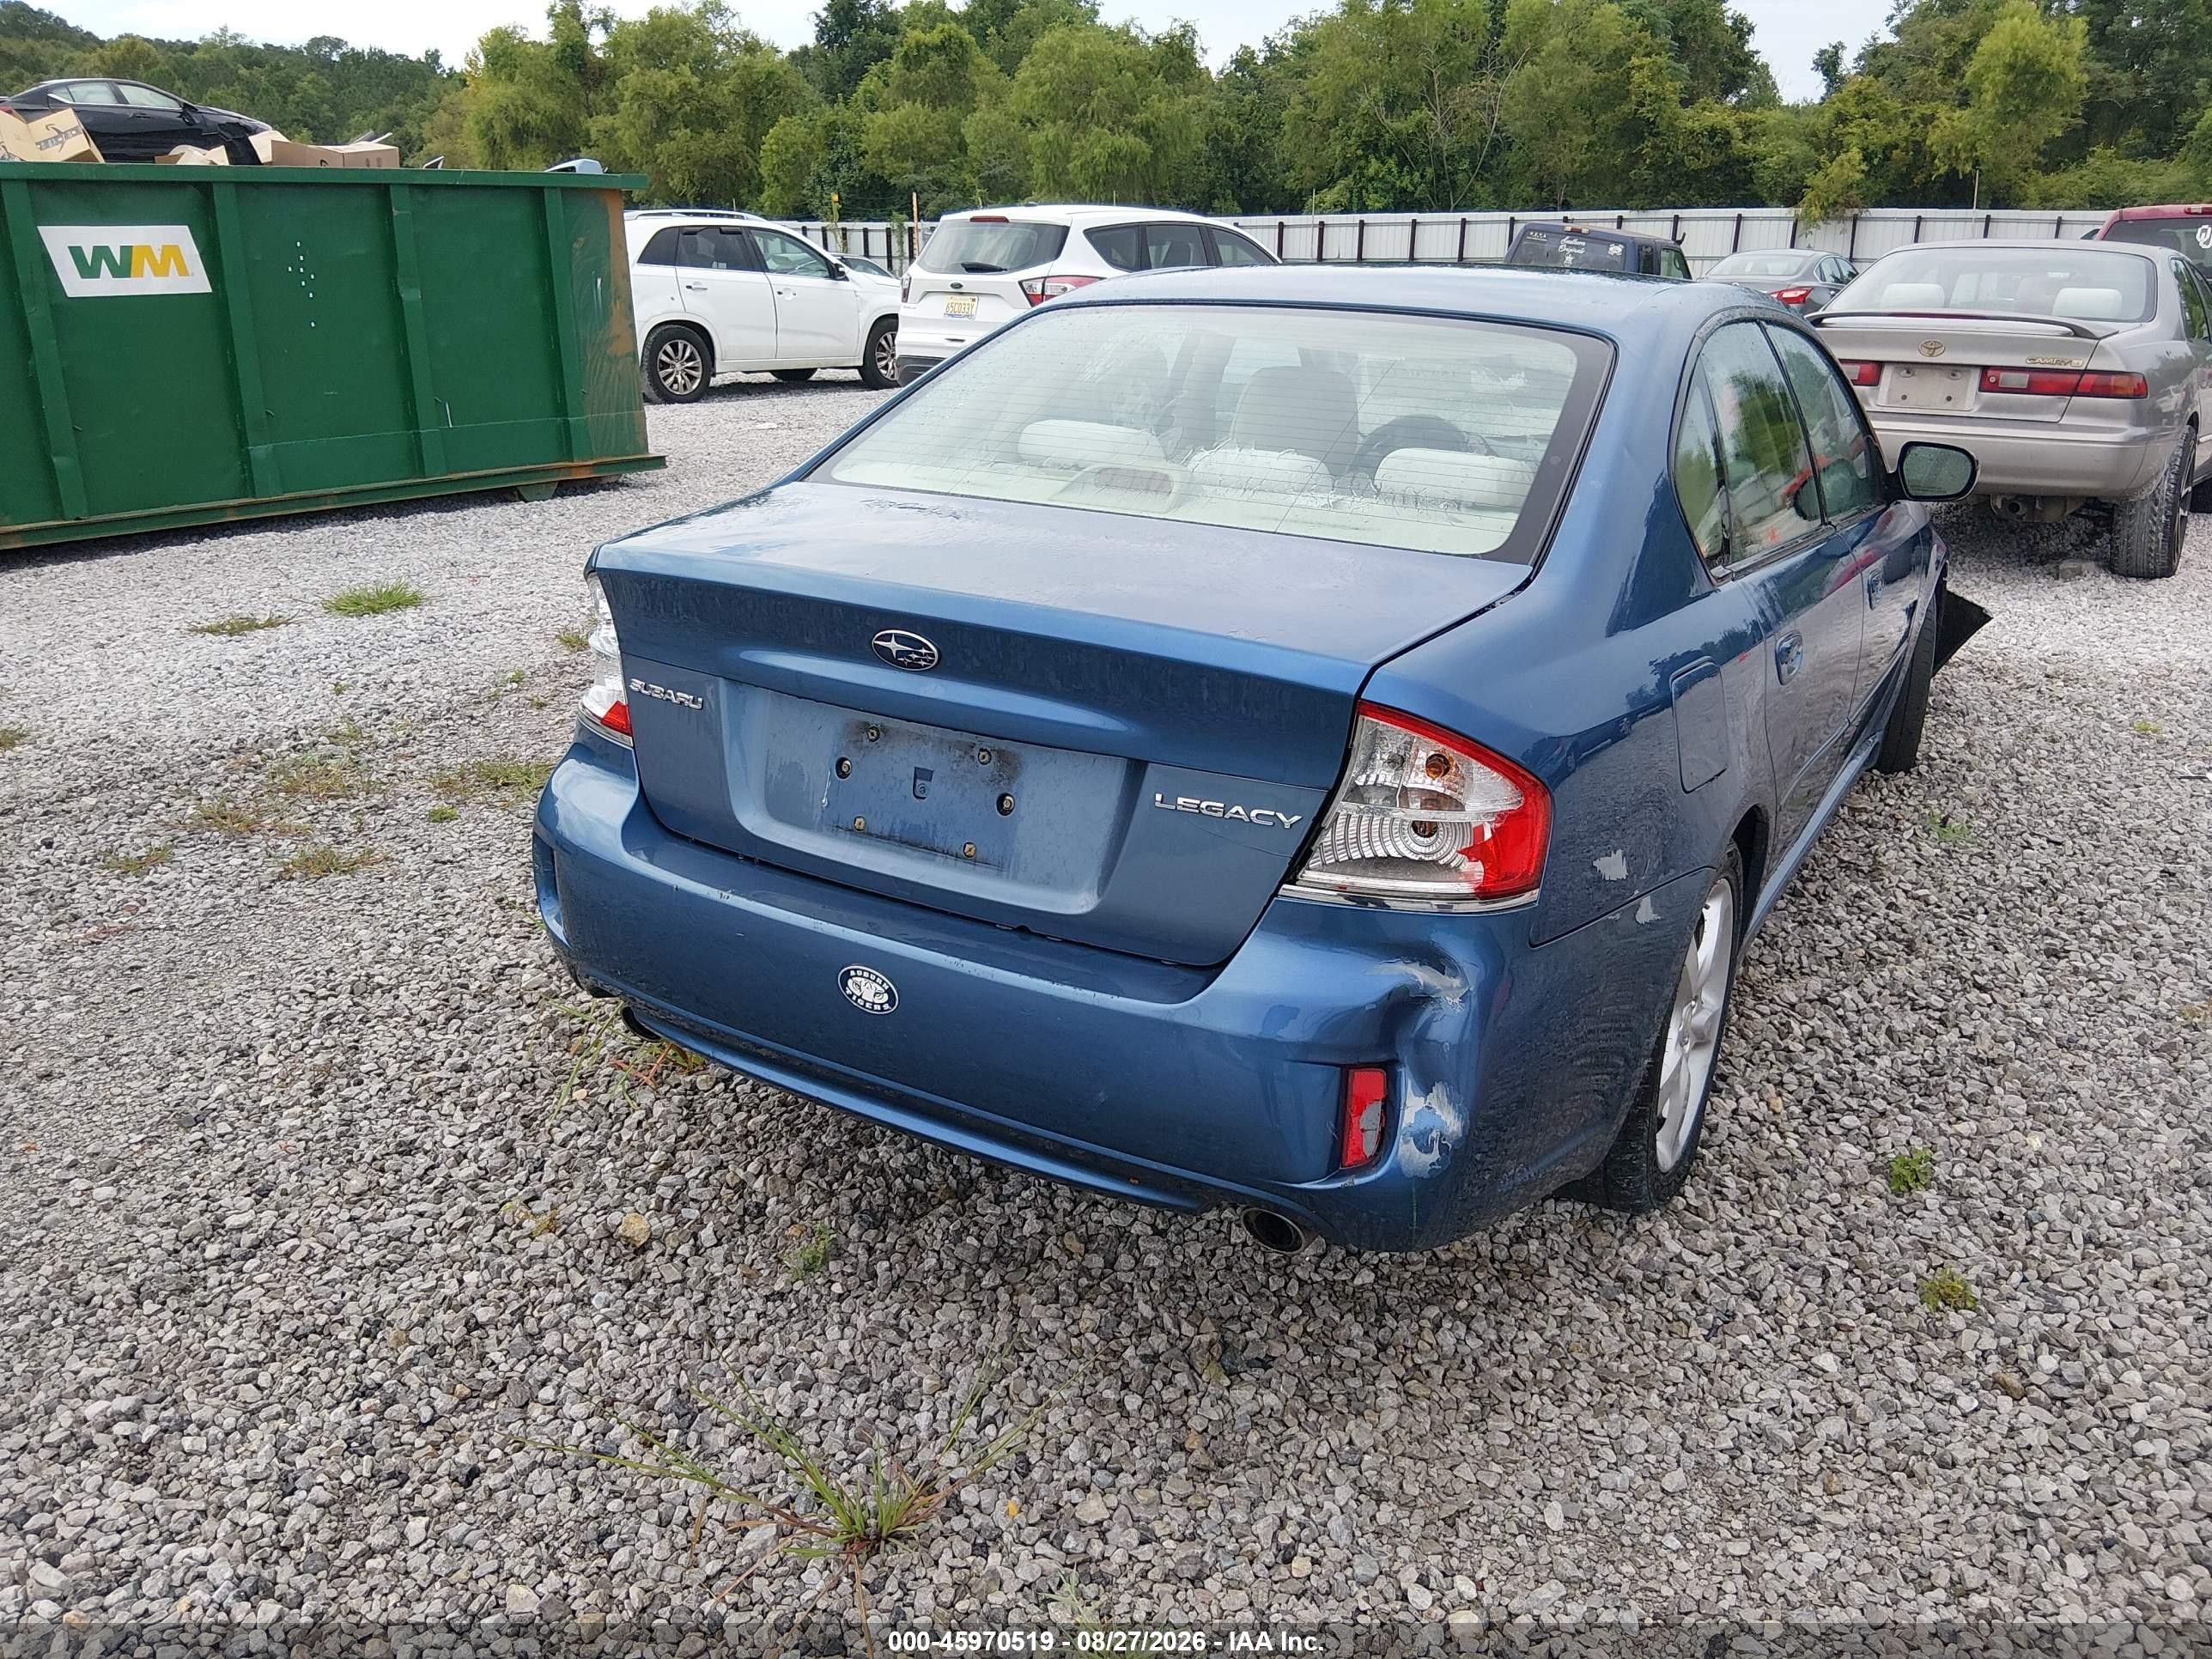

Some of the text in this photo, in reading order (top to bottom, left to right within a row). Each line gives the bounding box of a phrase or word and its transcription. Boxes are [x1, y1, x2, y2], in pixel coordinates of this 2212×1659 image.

[68, 245, 191, 279] WM
[2027, 357, 2071, 366] CAMRY
[629, 678, 703, 710] SUBARU
[1155, 793, 1303, 829] LEGACY
[849, 969, 890, 990] AUBURN
[845, 987, 890, 1011] TIGERS
